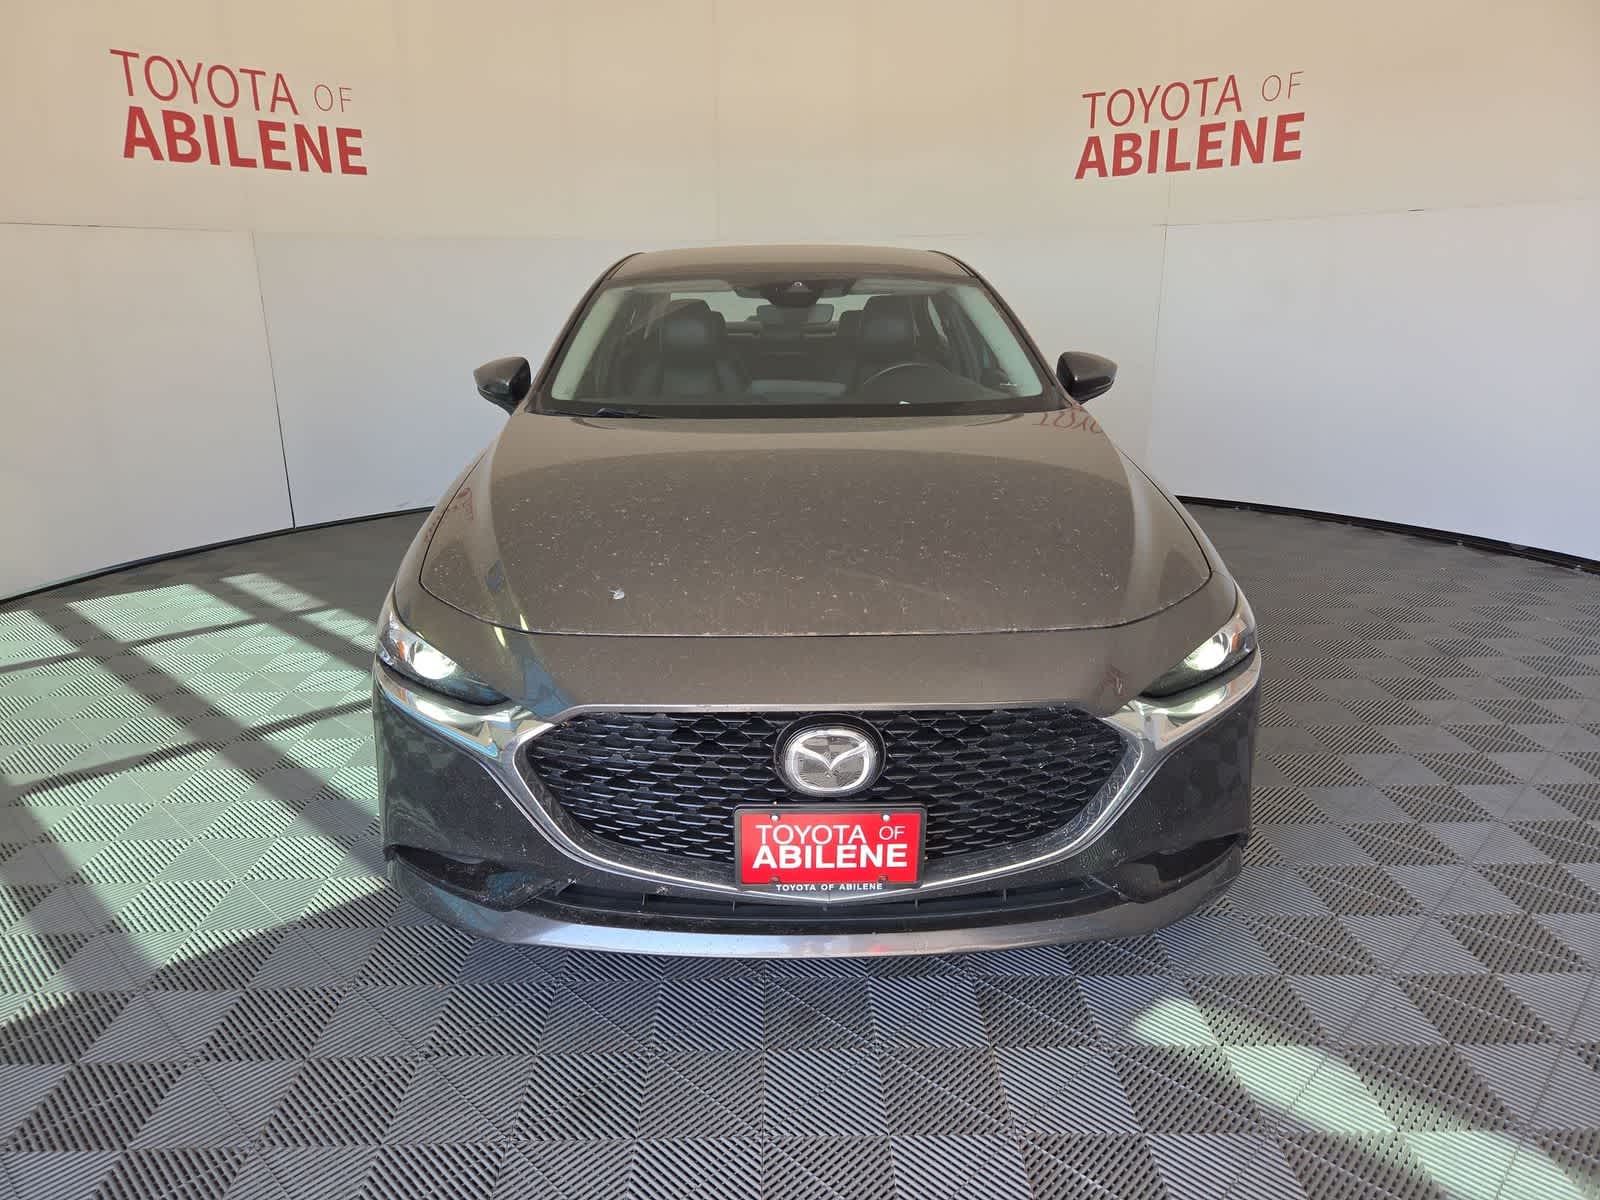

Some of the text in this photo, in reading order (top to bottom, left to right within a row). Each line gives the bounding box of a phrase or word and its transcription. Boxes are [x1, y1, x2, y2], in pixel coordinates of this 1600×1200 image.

[109, 48, 352, 115] TOYOTA OF
[1082, 71, 1304, 129] TOYOTA OF
[123, 105, 368, 176] ABILENE
[1074, 112, 1305, 180] ABILENE
[752, 843, 908, 869] ABILENE
[755, 824, 905, 845] TOYOTA OF
[776, 882, 883, 891] TOYOTA OF ABILENE
